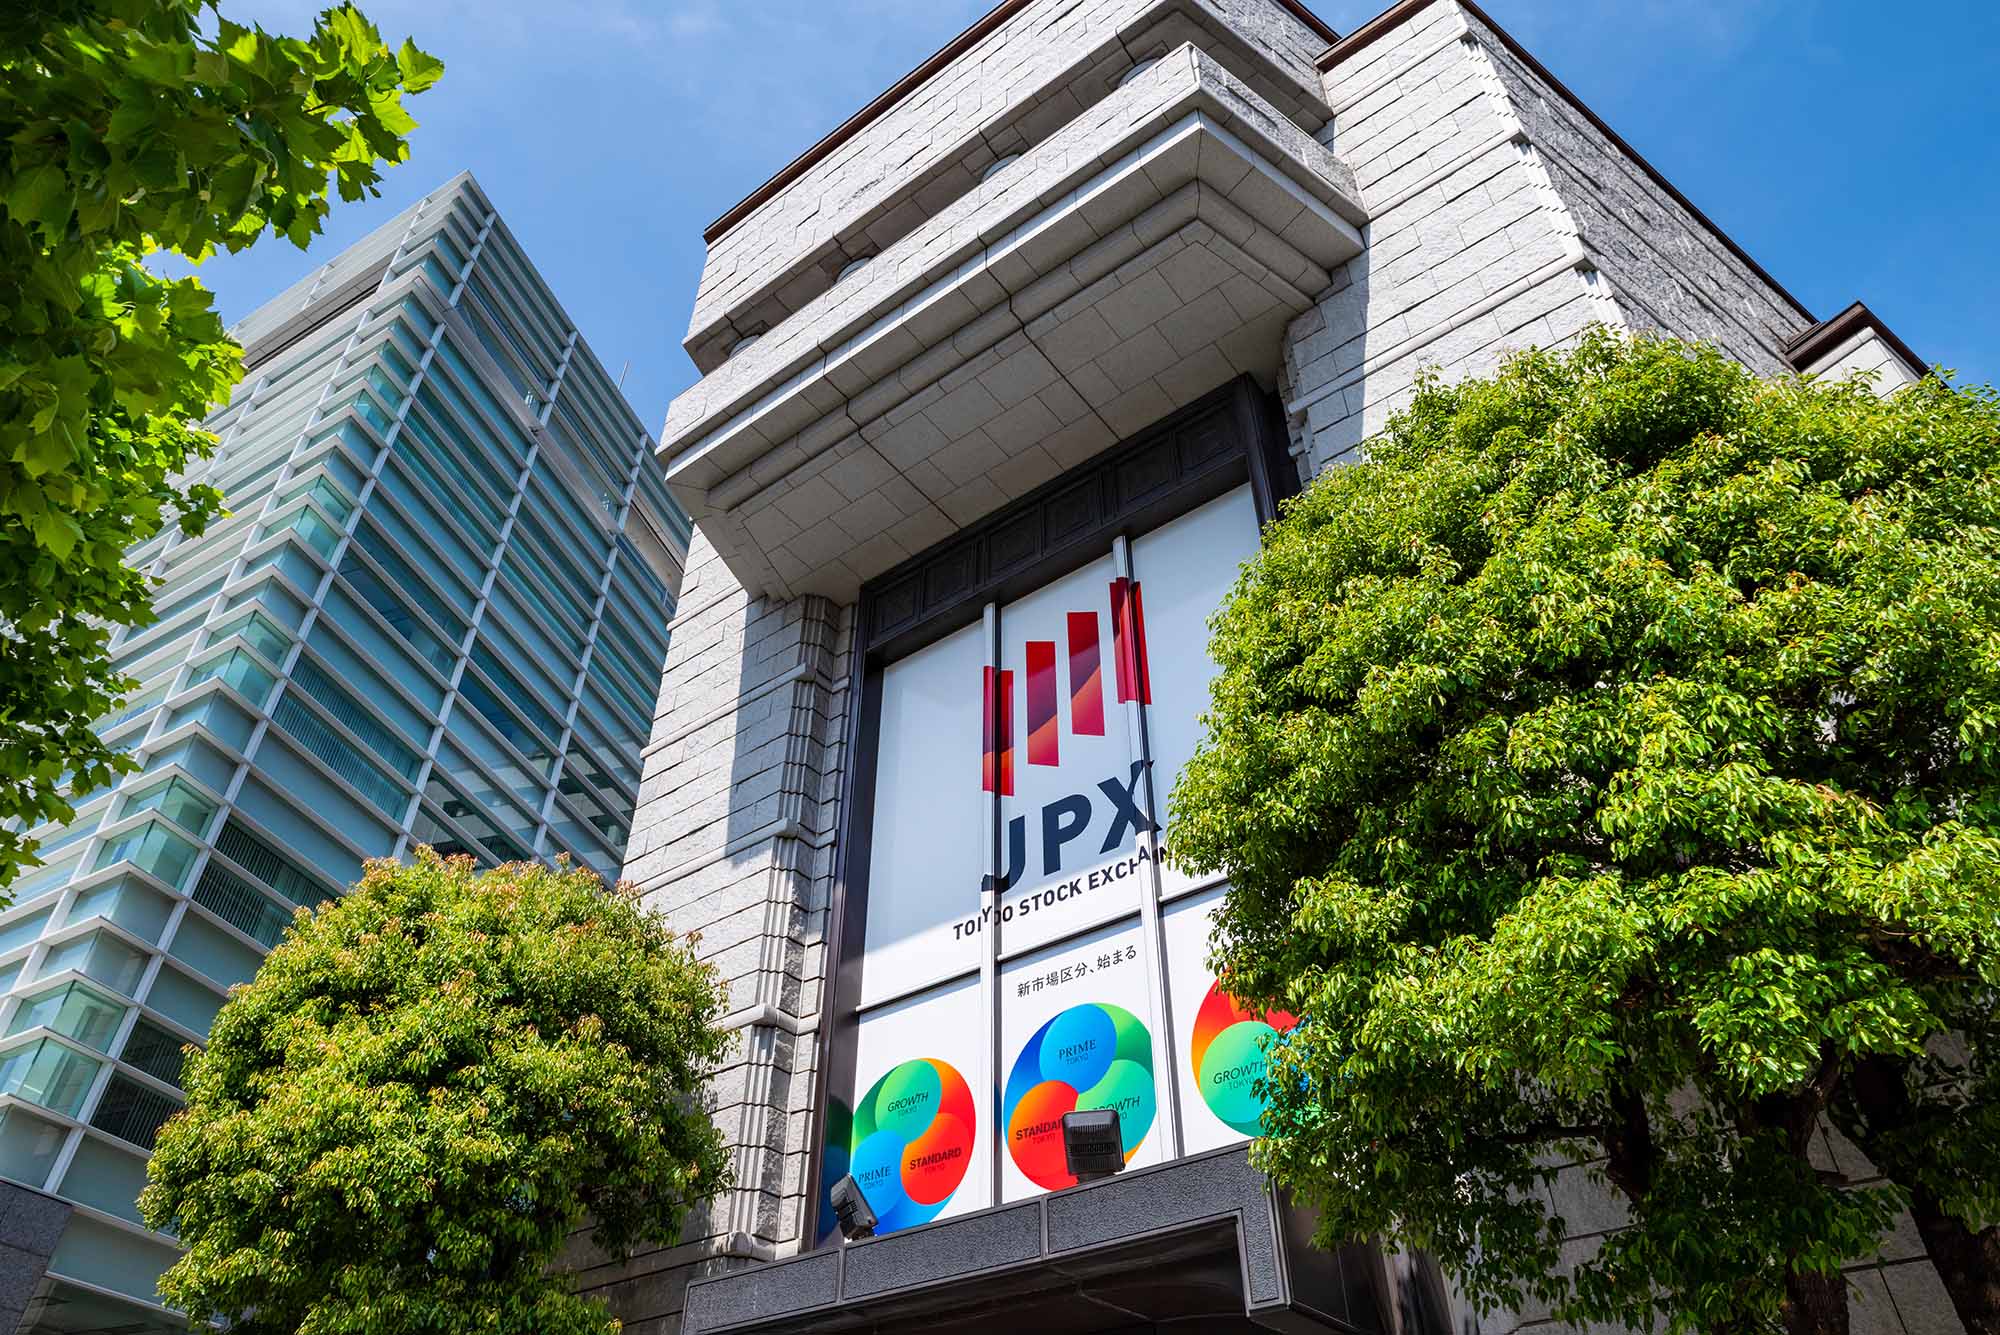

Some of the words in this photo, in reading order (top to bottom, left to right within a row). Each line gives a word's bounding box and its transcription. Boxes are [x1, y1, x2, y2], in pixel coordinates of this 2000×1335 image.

[981, 759, 1163, 894] JPX
[1019, 879, 1083, 916] STOCK
[1017, 945, 1137, 998] 新市場区分、始まる
[1059, 1039, 1097, 1060] PRIME
[1213, 1060, 1268, 1085] GROWTH
[887, 1091, 928, 1112] GROWTH
[909, 1147, 962, 1170] STANDARD
